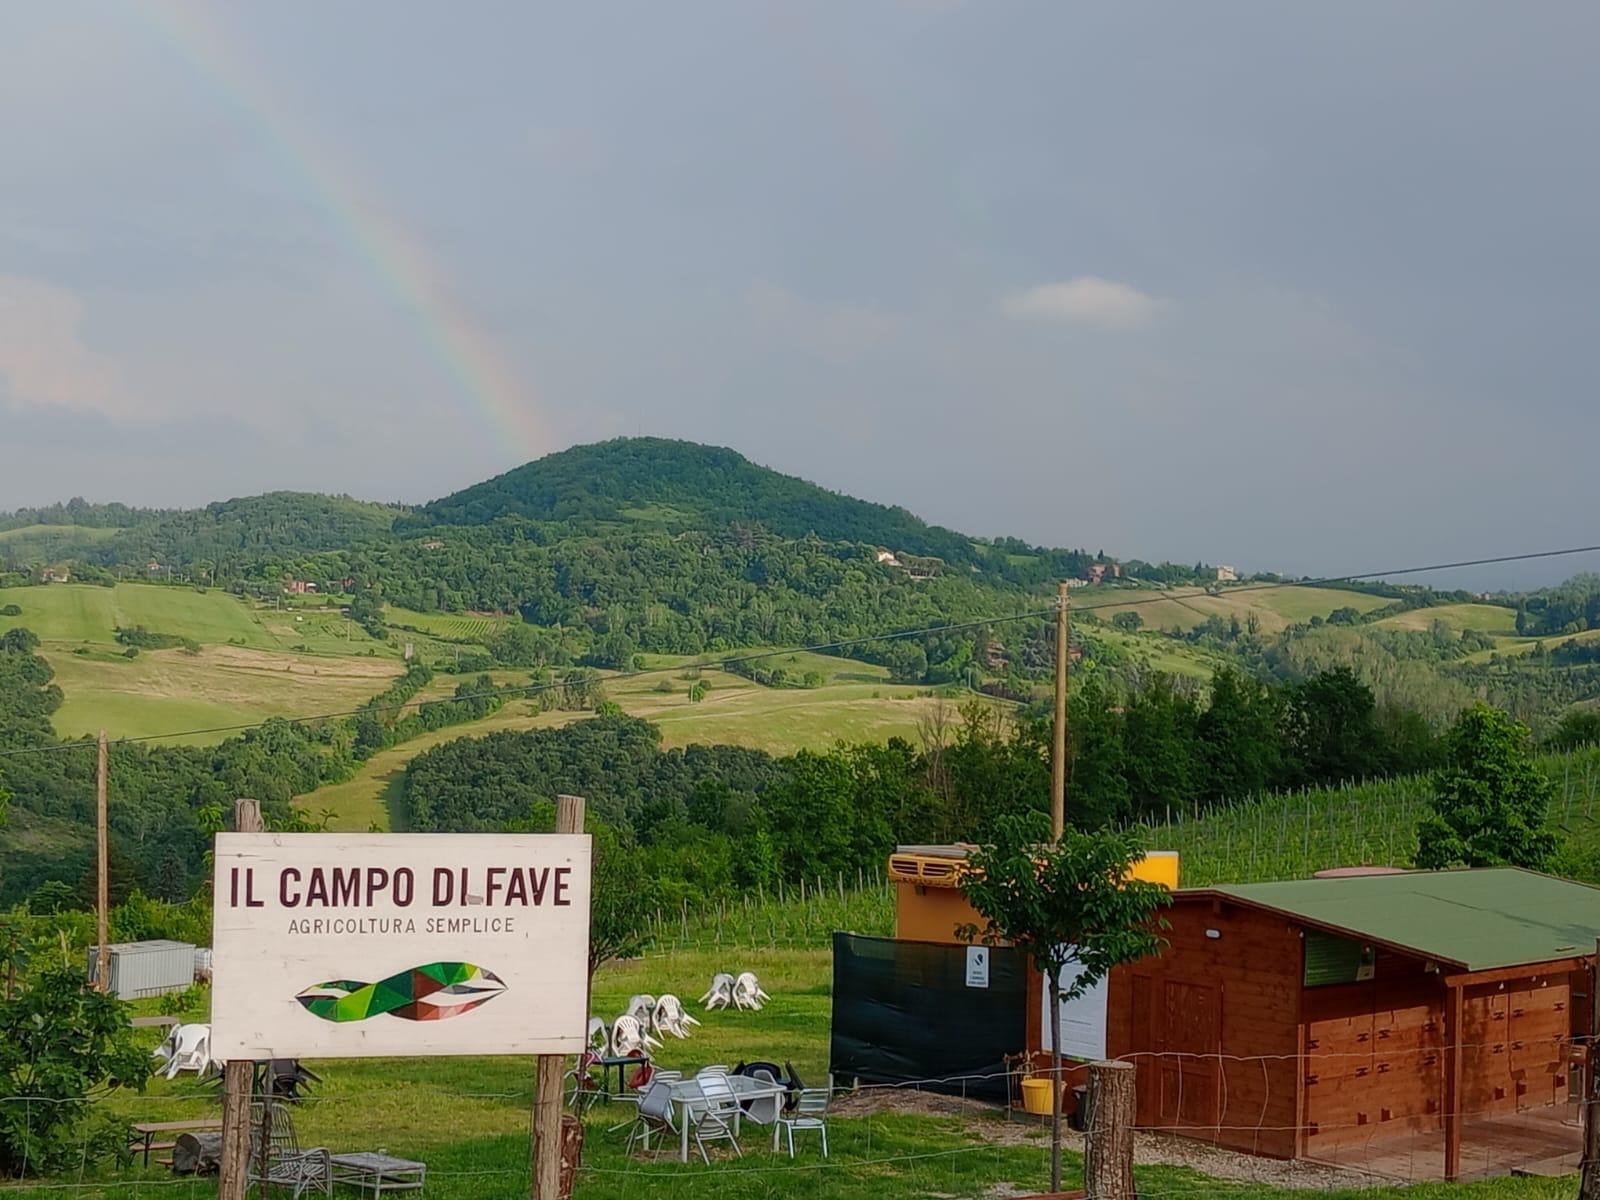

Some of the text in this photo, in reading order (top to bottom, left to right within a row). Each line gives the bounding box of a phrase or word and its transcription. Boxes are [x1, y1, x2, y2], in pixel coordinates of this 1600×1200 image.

[231, 867, 571, 907] IL CAMPO DI FAVE
[288, 918, 513, 934] AGRICOLTURA SEMPLICE
